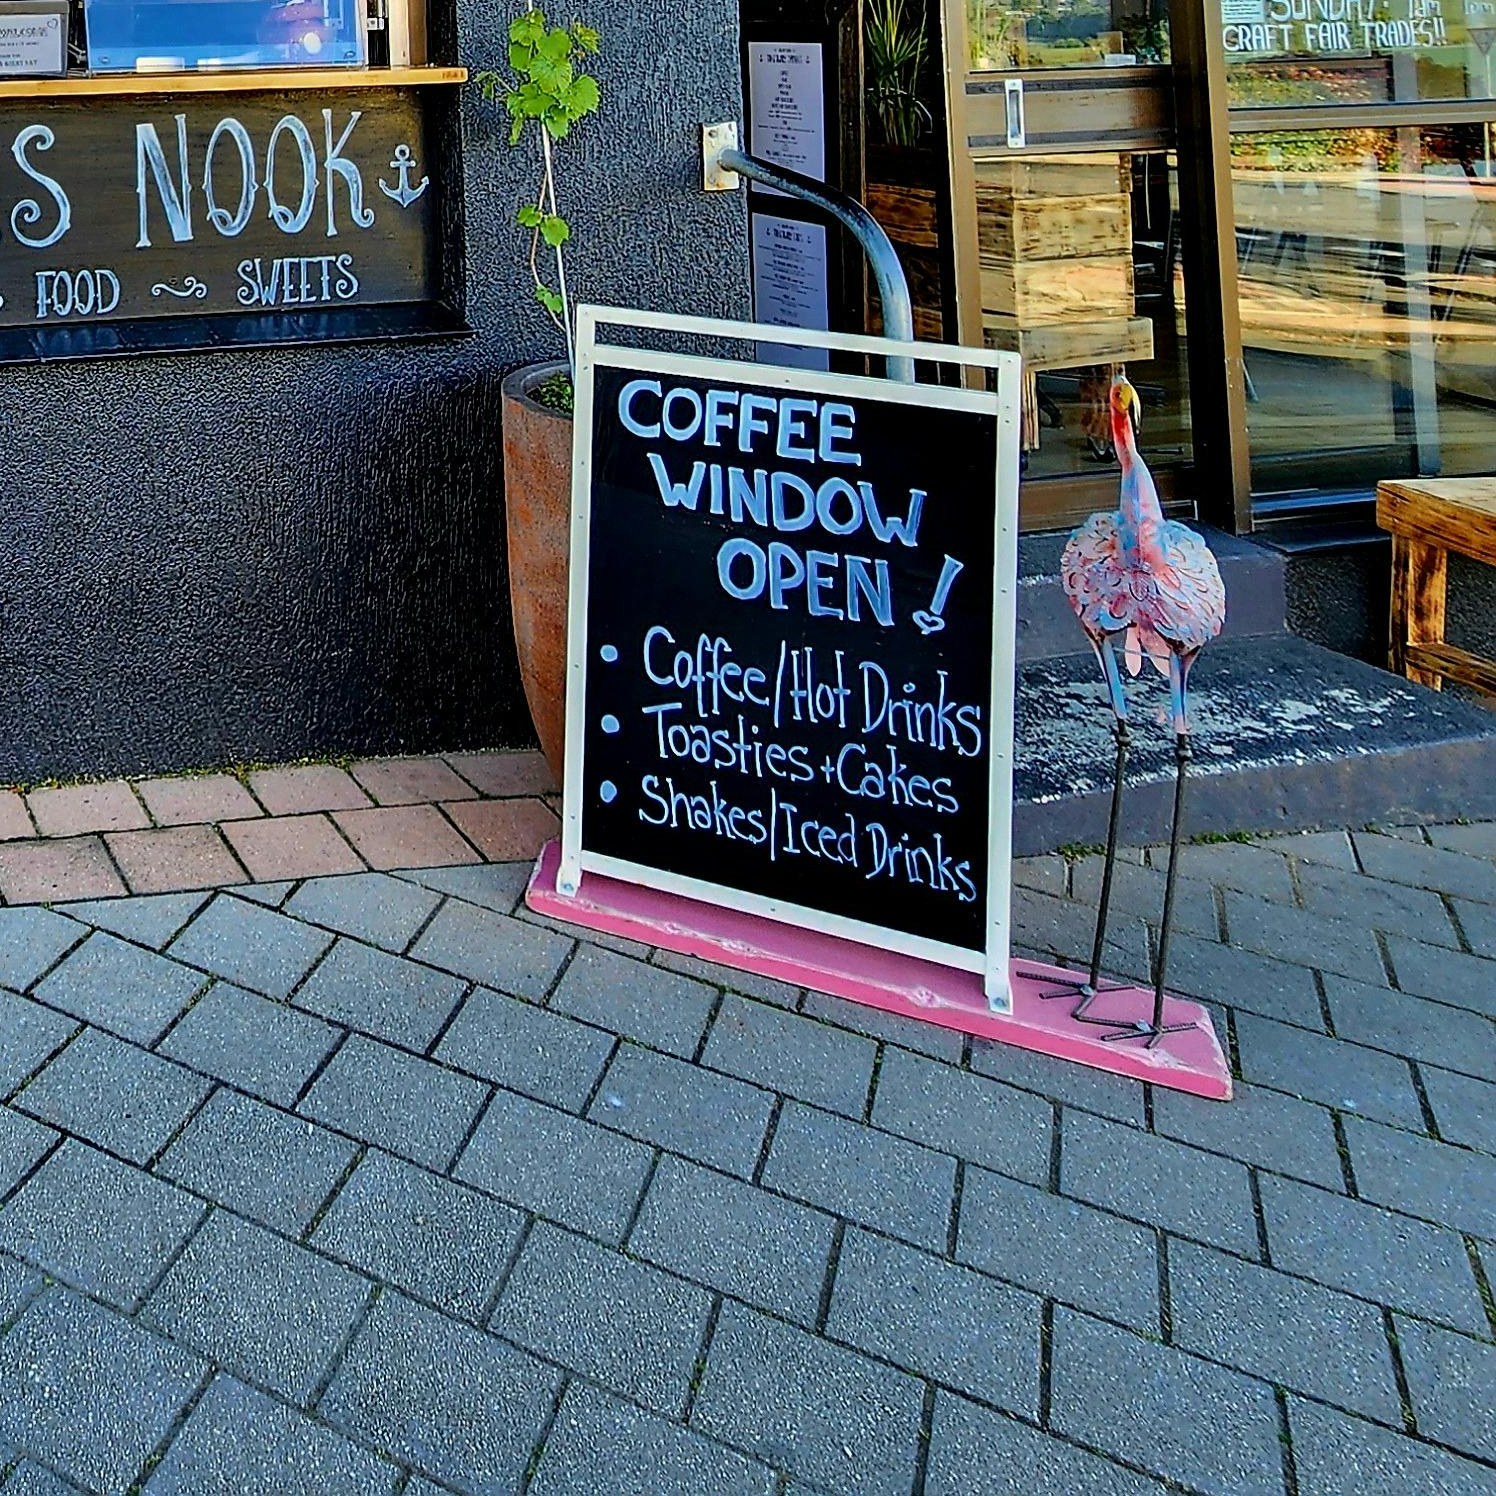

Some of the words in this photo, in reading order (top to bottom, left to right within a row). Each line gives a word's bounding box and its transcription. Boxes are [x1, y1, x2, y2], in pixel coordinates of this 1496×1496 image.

[1222, 24, 1294, 51] CRAFT
[1305, 21, 1352, 50] FAIR
[1361, 16, 1448, 49] TRADES!!
[135, 108, 375, 249] NOOK
[36, 268, 120, 320] FOOD
[236, 254, 359, 306] SWEETS
[618, 378, 862, 466] COFFEE
[647, 452, 927, 548] WINDOW
[860, 661, 982, 757] Drinks
[866, 821, 977, 902] Drinks
